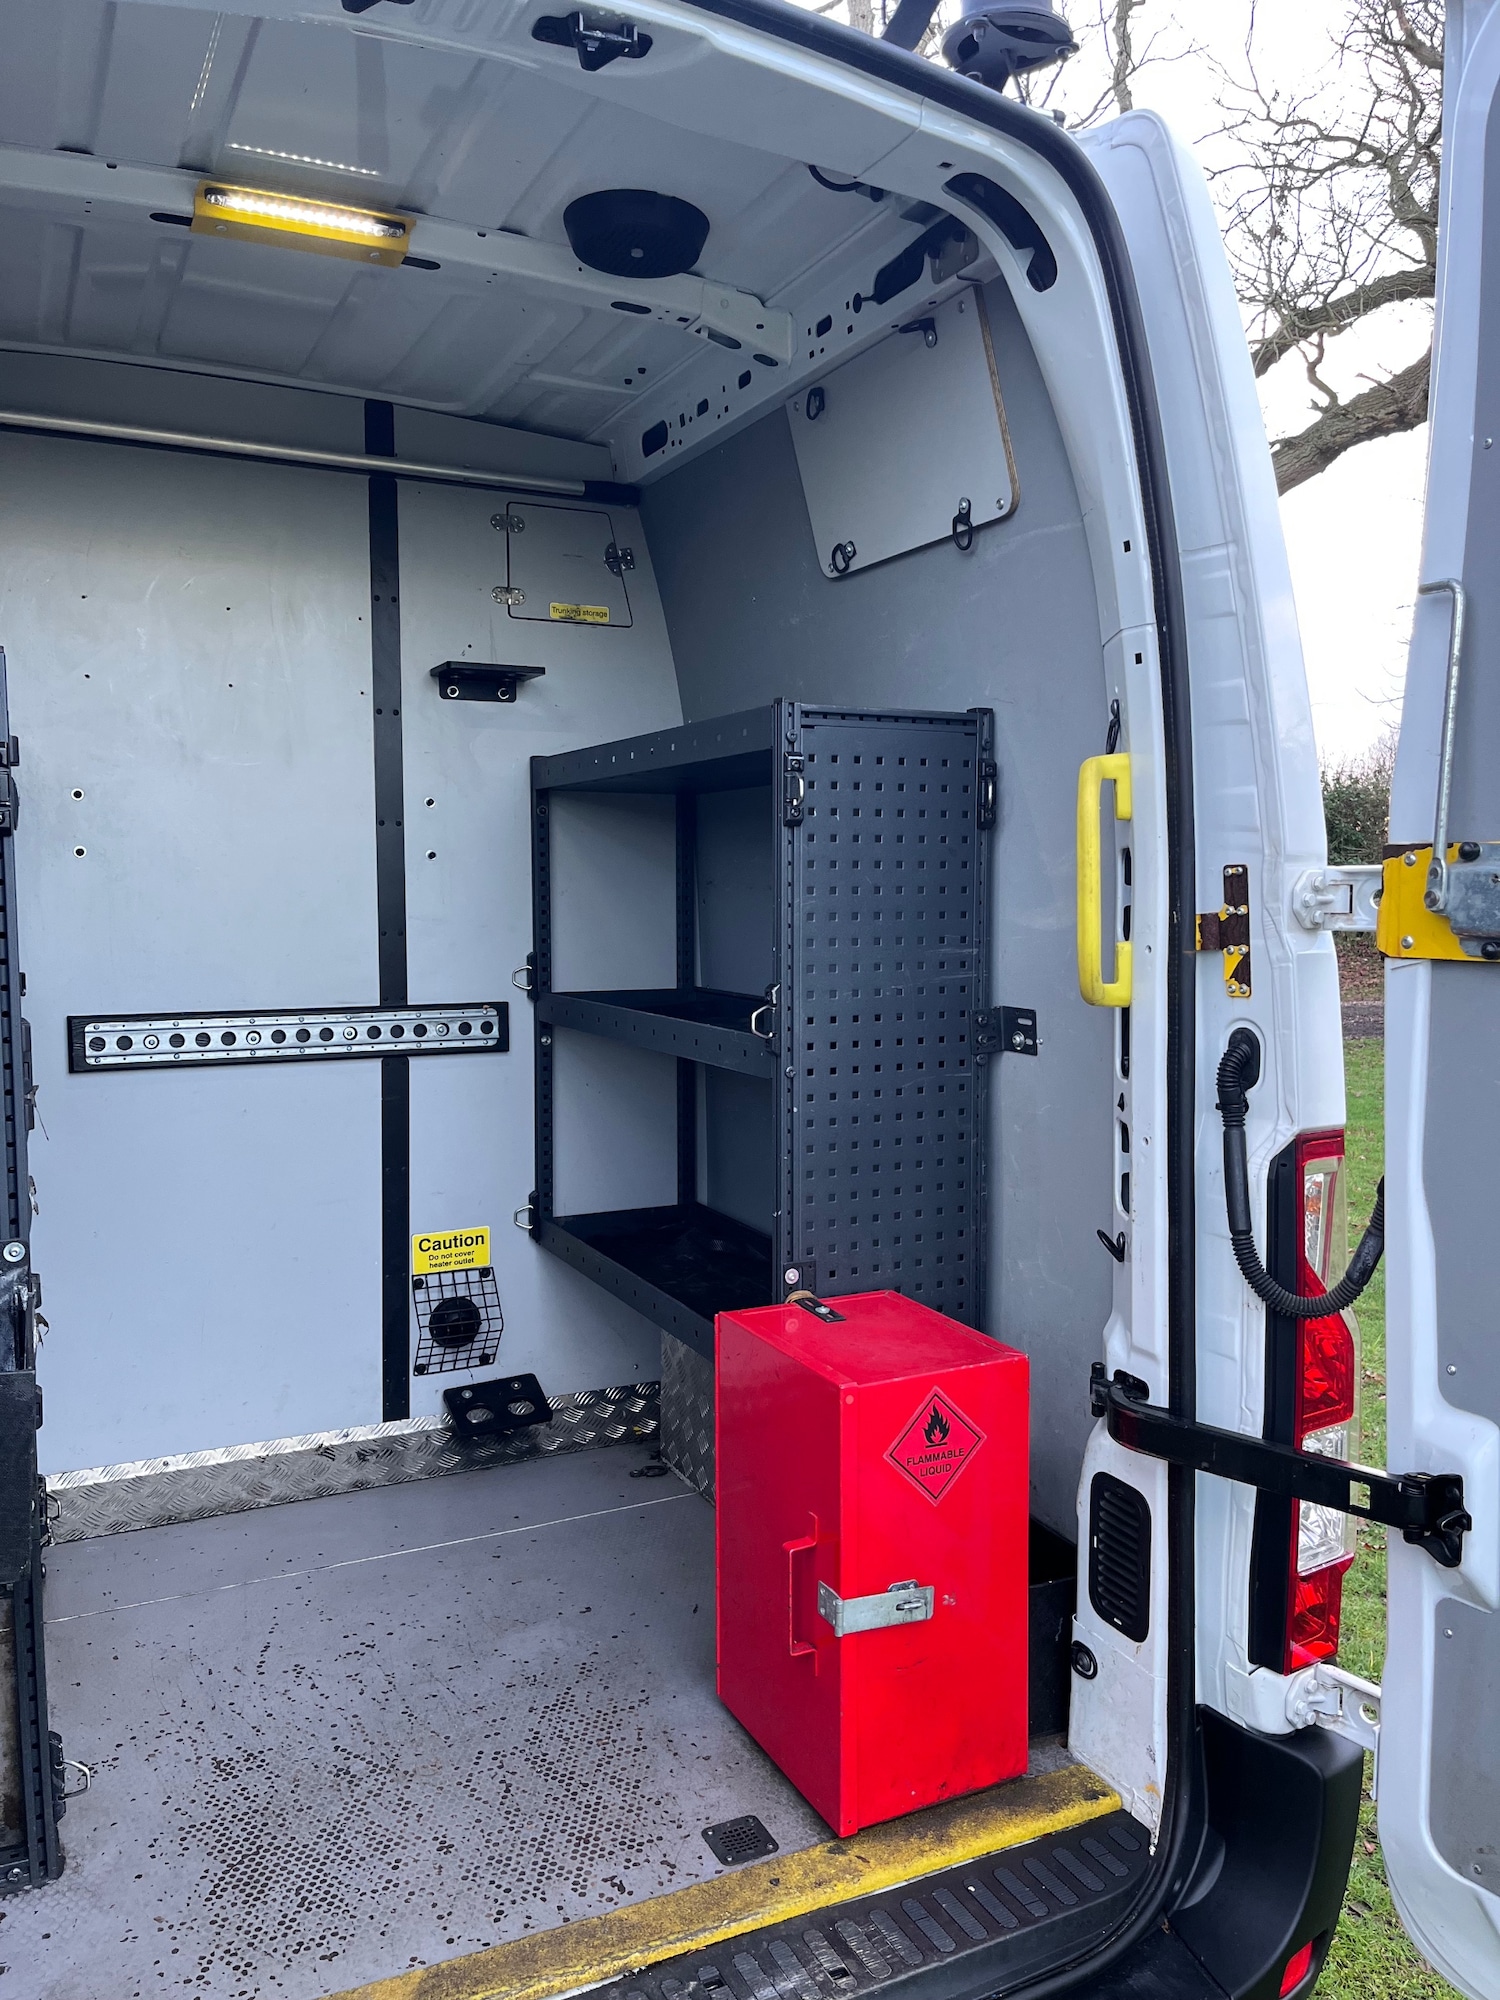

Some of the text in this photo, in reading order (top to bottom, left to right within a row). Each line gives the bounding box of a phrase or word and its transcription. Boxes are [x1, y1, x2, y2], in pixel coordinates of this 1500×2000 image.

[552, 606, 607, 618] Trunking storage
[418, 1234, 484, 1252] Caution
[454, 1250, 475, 1258] cover
[453, 1257, 474, 1265] outlet
[906, 1448, 965, 1466] FLAMMABLE
[920, 1463, 952, 1477] LIQUID
